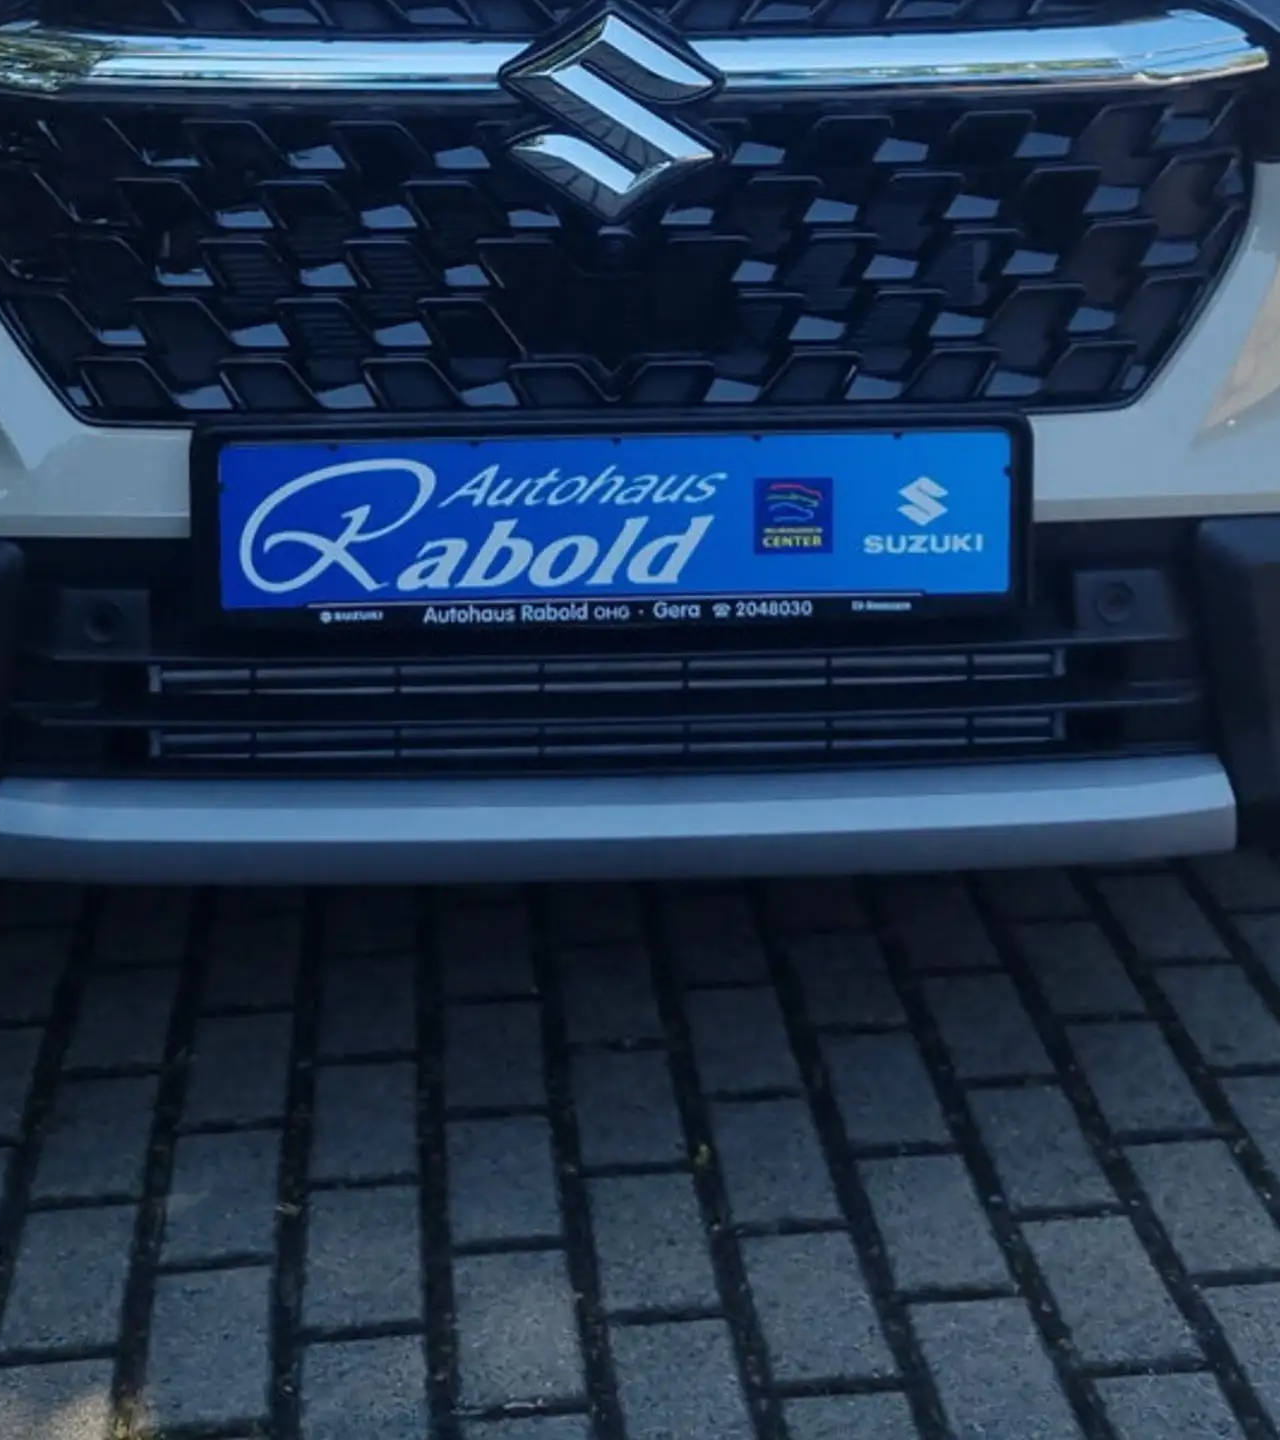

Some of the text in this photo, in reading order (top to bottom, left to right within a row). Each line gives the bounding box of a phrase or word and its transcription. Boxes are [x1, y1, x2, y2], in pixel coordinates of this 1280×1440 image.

[437, 463, 728, 508] Autohaus
[240, 458, 716, 593] Rabold
[762, 535, 823, 549] CENTER
[863, 533, 984, 555] SUZUKI
[423, 605, 516, 624] Autohaus
[521, 602, 589, 622] Rabold
[652, 601, 702, 619] Gera
[735, 599, 814, 618] 2048030
